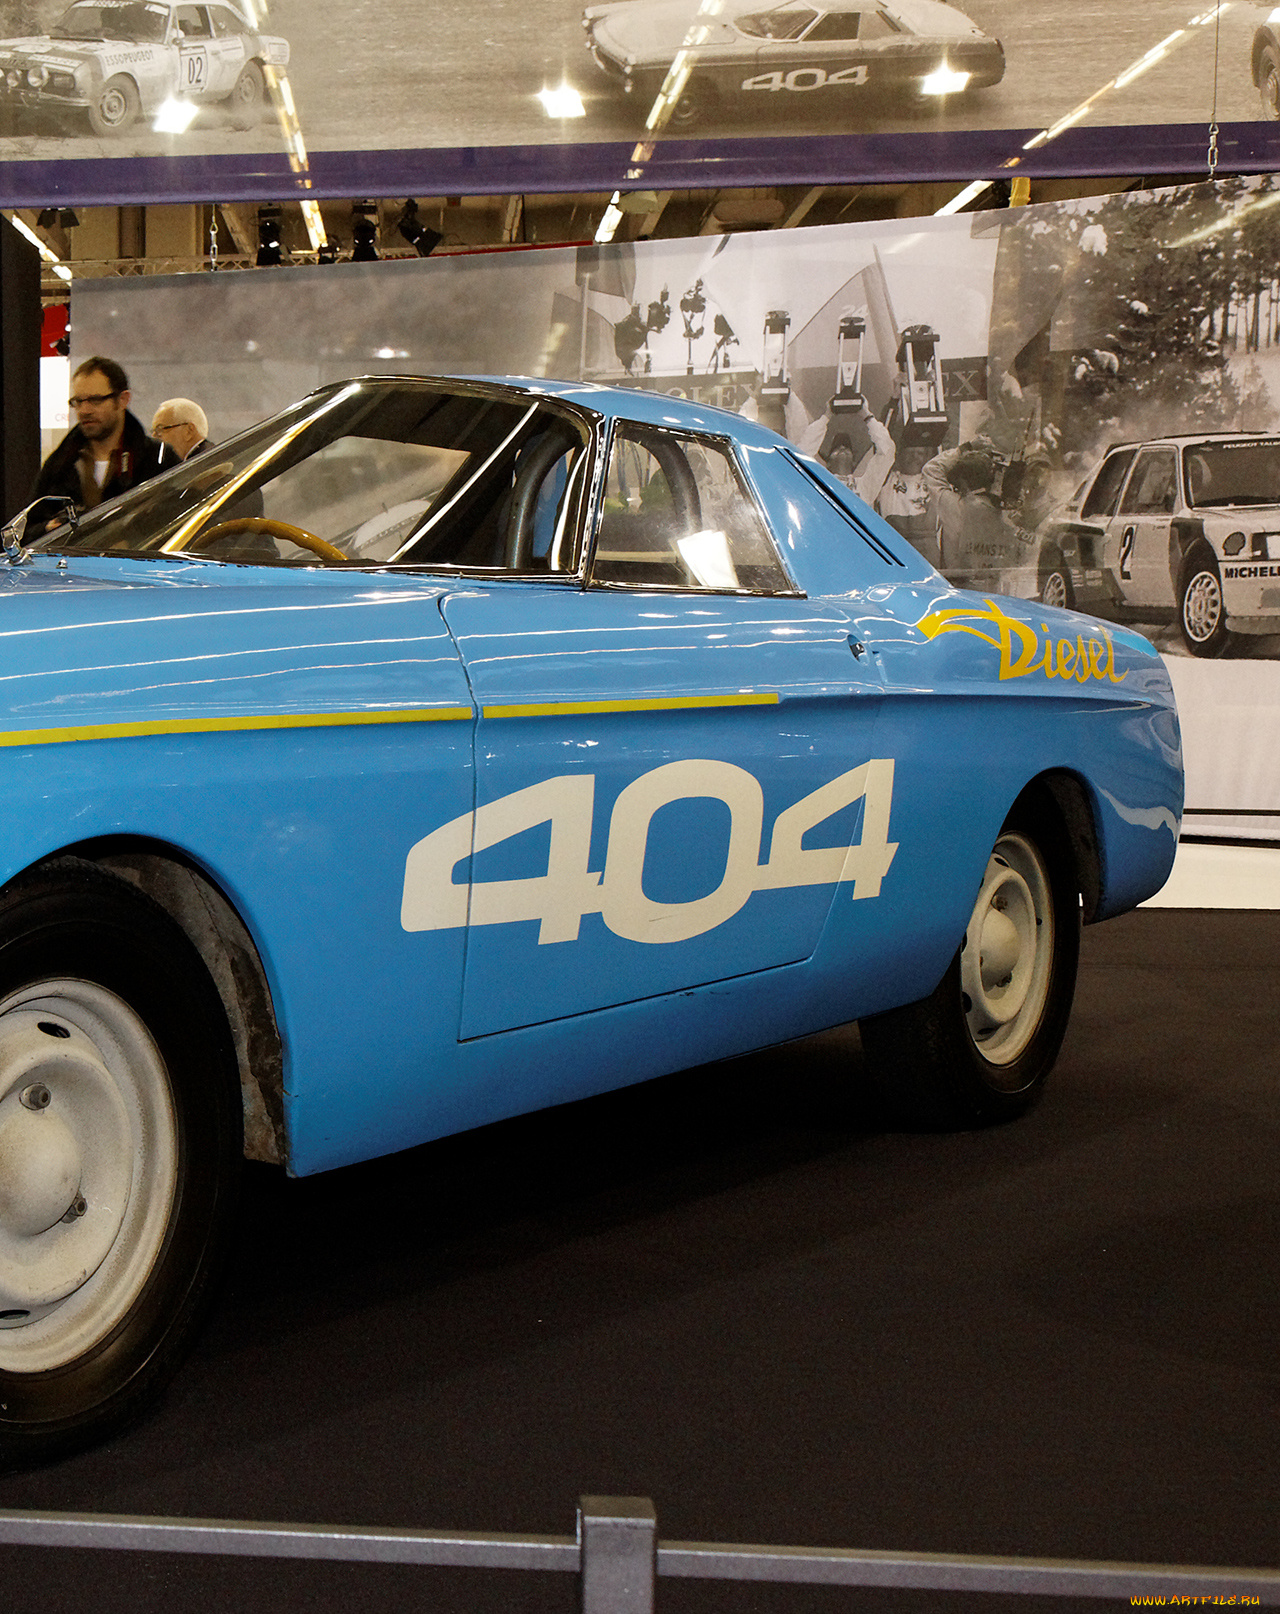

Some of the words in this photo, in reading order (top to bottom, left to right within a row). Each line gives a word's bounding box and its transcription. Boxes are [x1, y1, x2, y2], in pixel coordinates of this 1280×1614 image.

[188, 56, 203, 84] 02
[741, 65, 870, 92] 404
[1121, 526, 1135, 580] 2
[916, 599, 1130, 684] Diesel
[401, 758, 900, 945] 404
